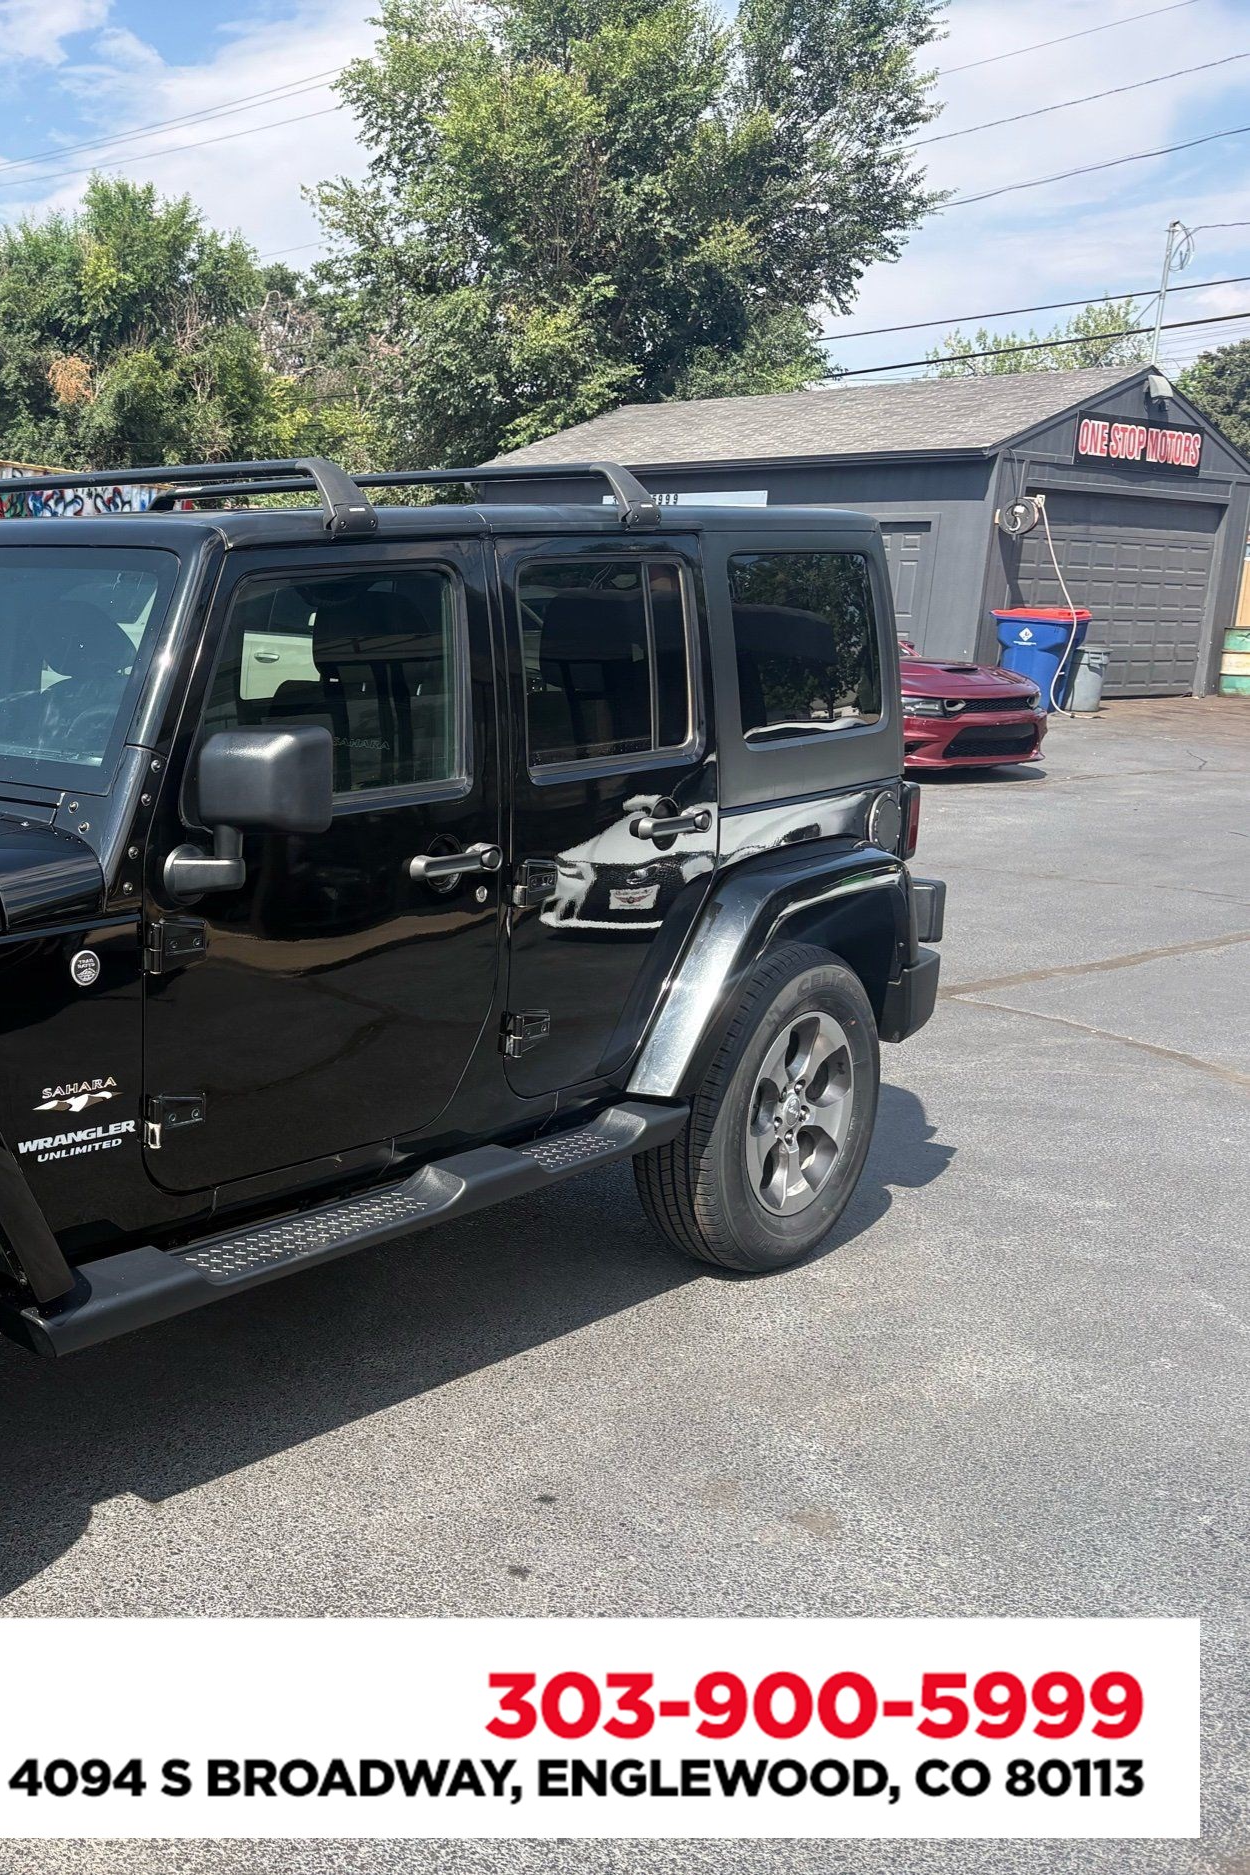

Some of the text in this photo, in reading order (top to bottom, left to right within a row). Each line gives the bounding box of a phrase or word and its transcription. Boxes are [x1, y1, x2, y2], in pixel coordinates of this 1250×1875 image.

[1078, 418, 1201, 467] ONE STOP MOTORS
[42, 1076, 117, 1099] SAHARA
[17, 1119, 136, 1154] WRANGLER
[37, 1138, 122, 1163] UNLIMITED
